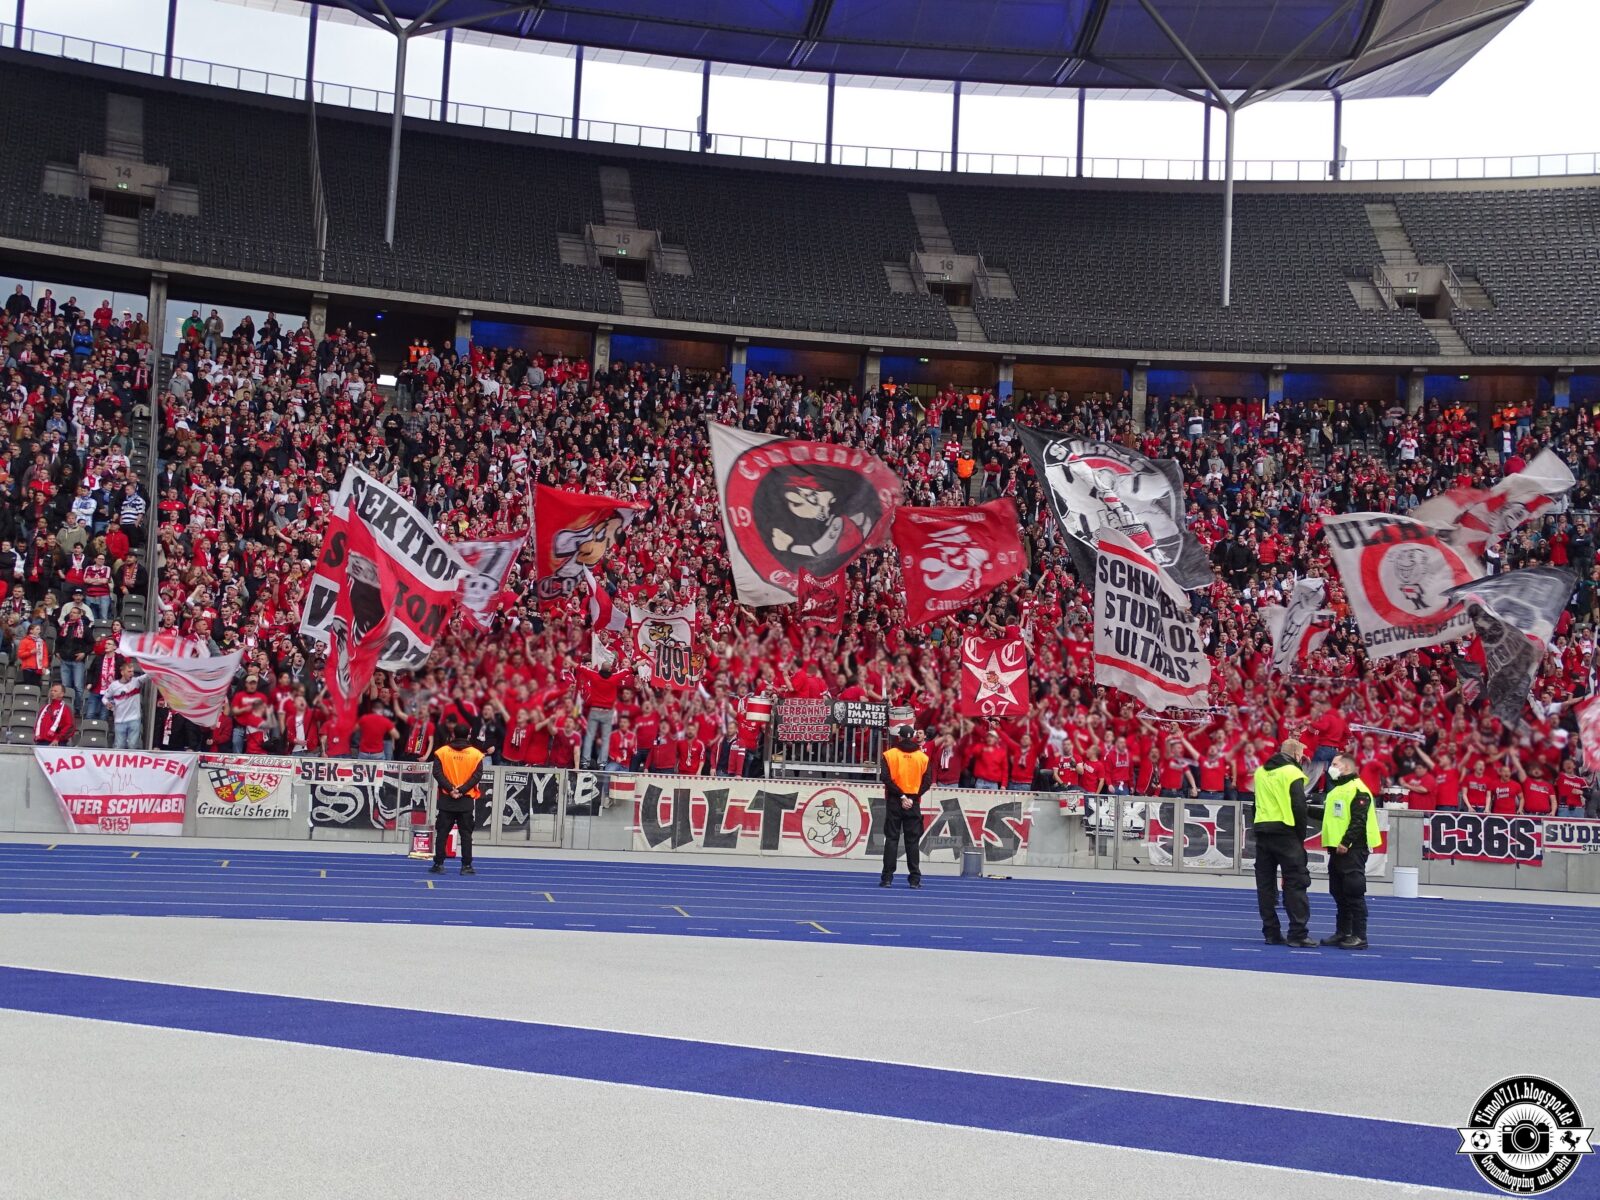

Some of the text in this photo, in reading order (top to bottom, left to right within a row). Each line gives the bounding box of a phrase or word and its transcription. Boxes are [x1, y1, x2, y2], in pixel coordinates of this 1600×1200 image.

[115, 166, 132, 178] 14
[616, 233, 631, 245] 15
[940, 260, 954, 271] 16
[1405, 271, 1419, 283] 17
[729, 506, 753, 527] 19
[351, 475, 462, 582] SEKTION
[1115, 627, 1190, 683] ULTRAS
[847, 702, 887, 712] DU BIST
[847, 710, 886, 720] IMMER
[981, 700, 1010, 716] 97
[865, 719, 886, 727] UNS!
[44, 755, 86, 776] BAD
[93, 753, 190, 779] WIMPFEN
[301, 762, 345, 782] SEK.
[352, 764, 378, 783] SV
[107, 798, 185, 815] SCHWABEN
[198, 802, 289, 818] Gundelsheim
[1430, 813, 1537, 861] C36S
